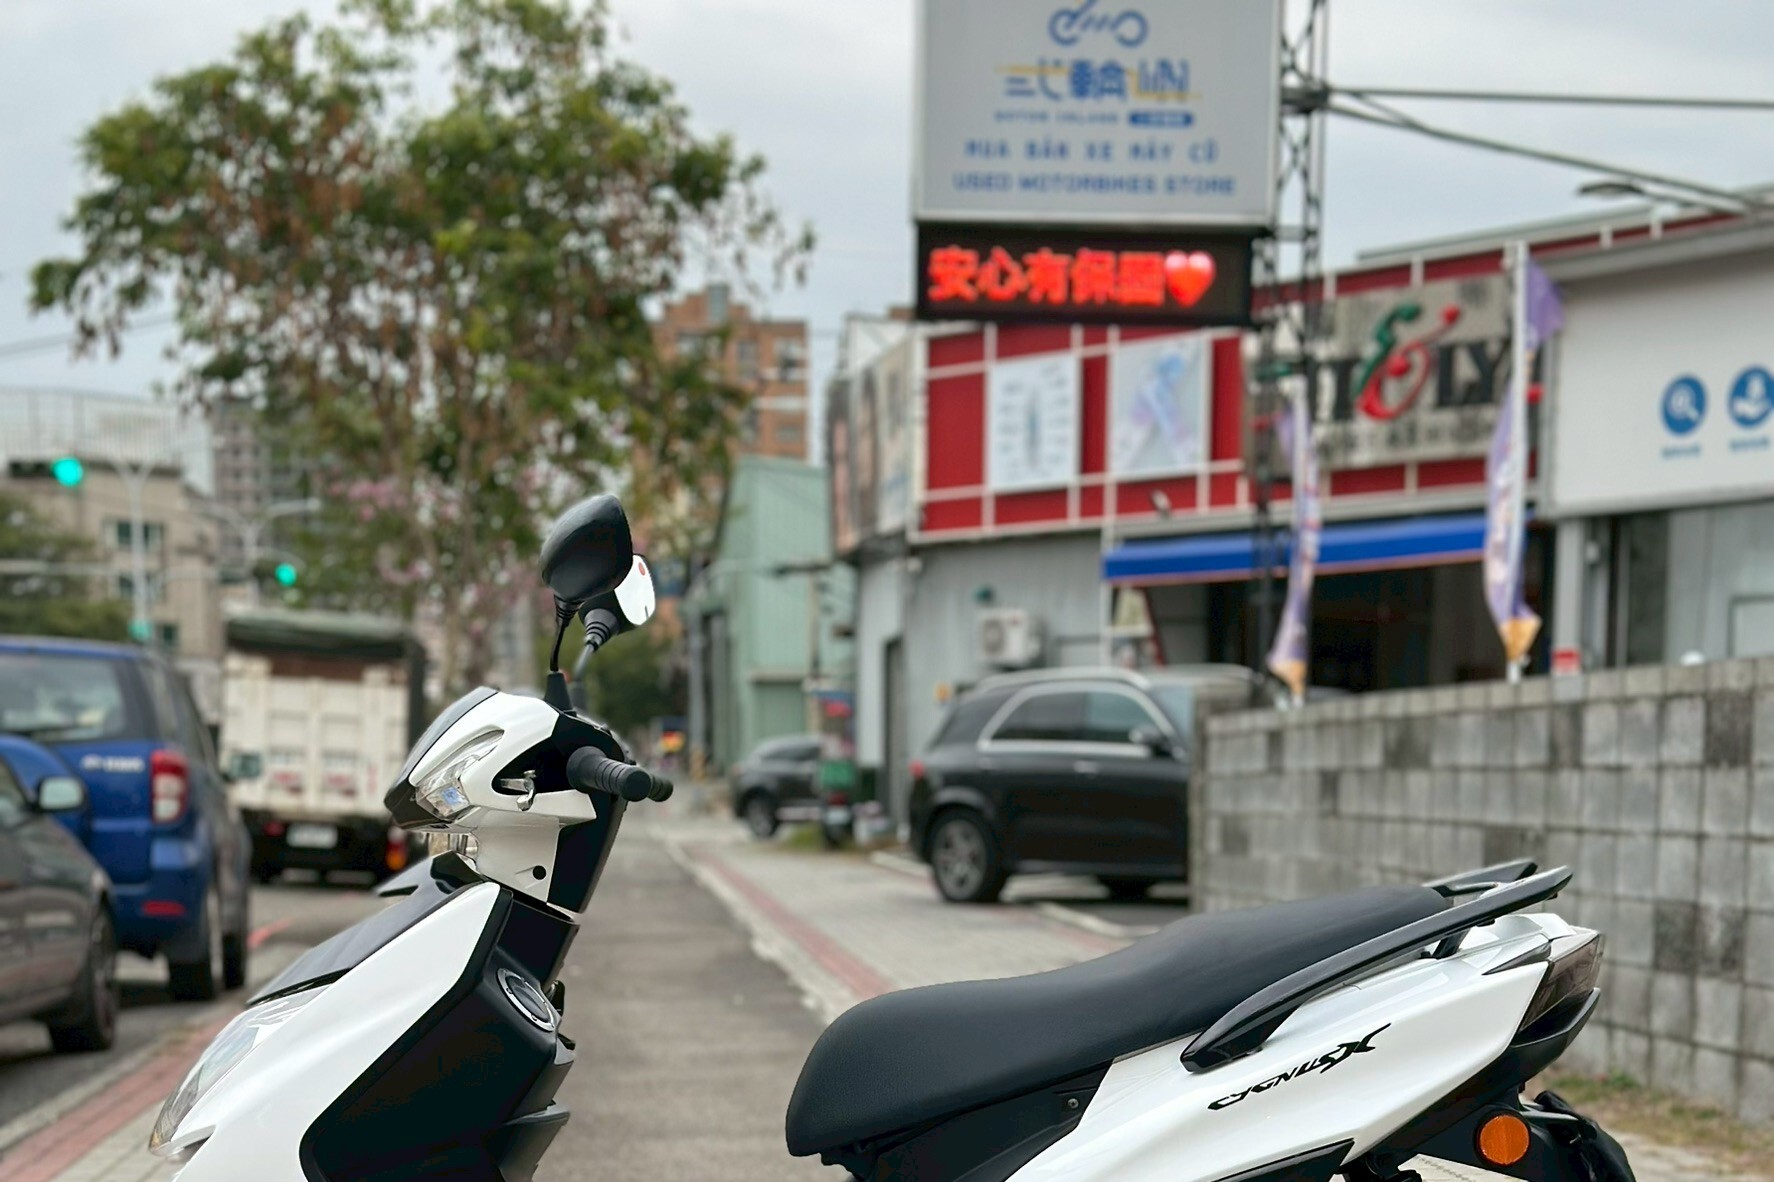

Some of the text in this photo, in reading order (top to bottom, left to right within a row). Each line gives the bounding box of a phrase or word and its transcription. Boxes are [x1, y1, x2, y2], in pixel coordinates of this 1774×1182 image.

[953, 173, 1236, 193] USED MOTORBIKES STORE
